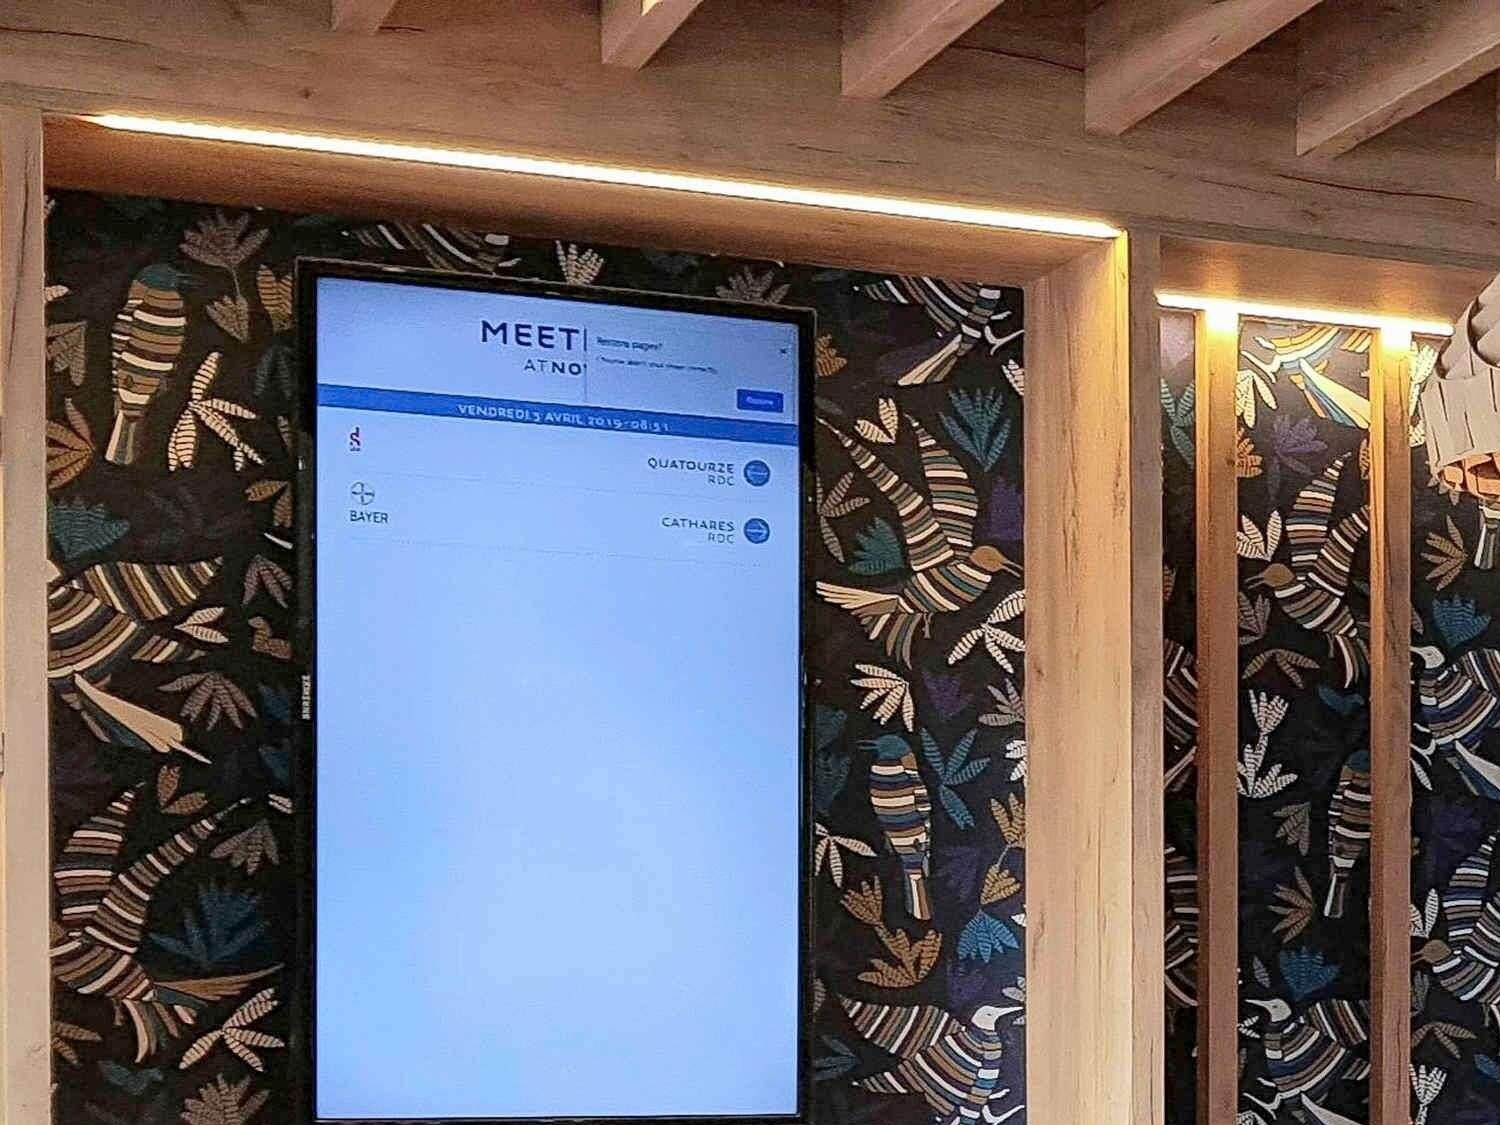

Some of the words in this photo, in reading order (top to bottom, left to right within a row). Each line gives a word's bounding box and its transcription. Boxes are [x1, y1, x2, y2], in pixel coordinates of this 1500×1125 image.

[458, 404, 529, 420] VENDREDI
[544, 412, 583, 424] AVRIL
[708, 475, 735, 487] RDC
[350, 510, 388, 523] BAYER
[662, 517, 735, 532] CATHARES
[708, 533, 735, 544] RDC
